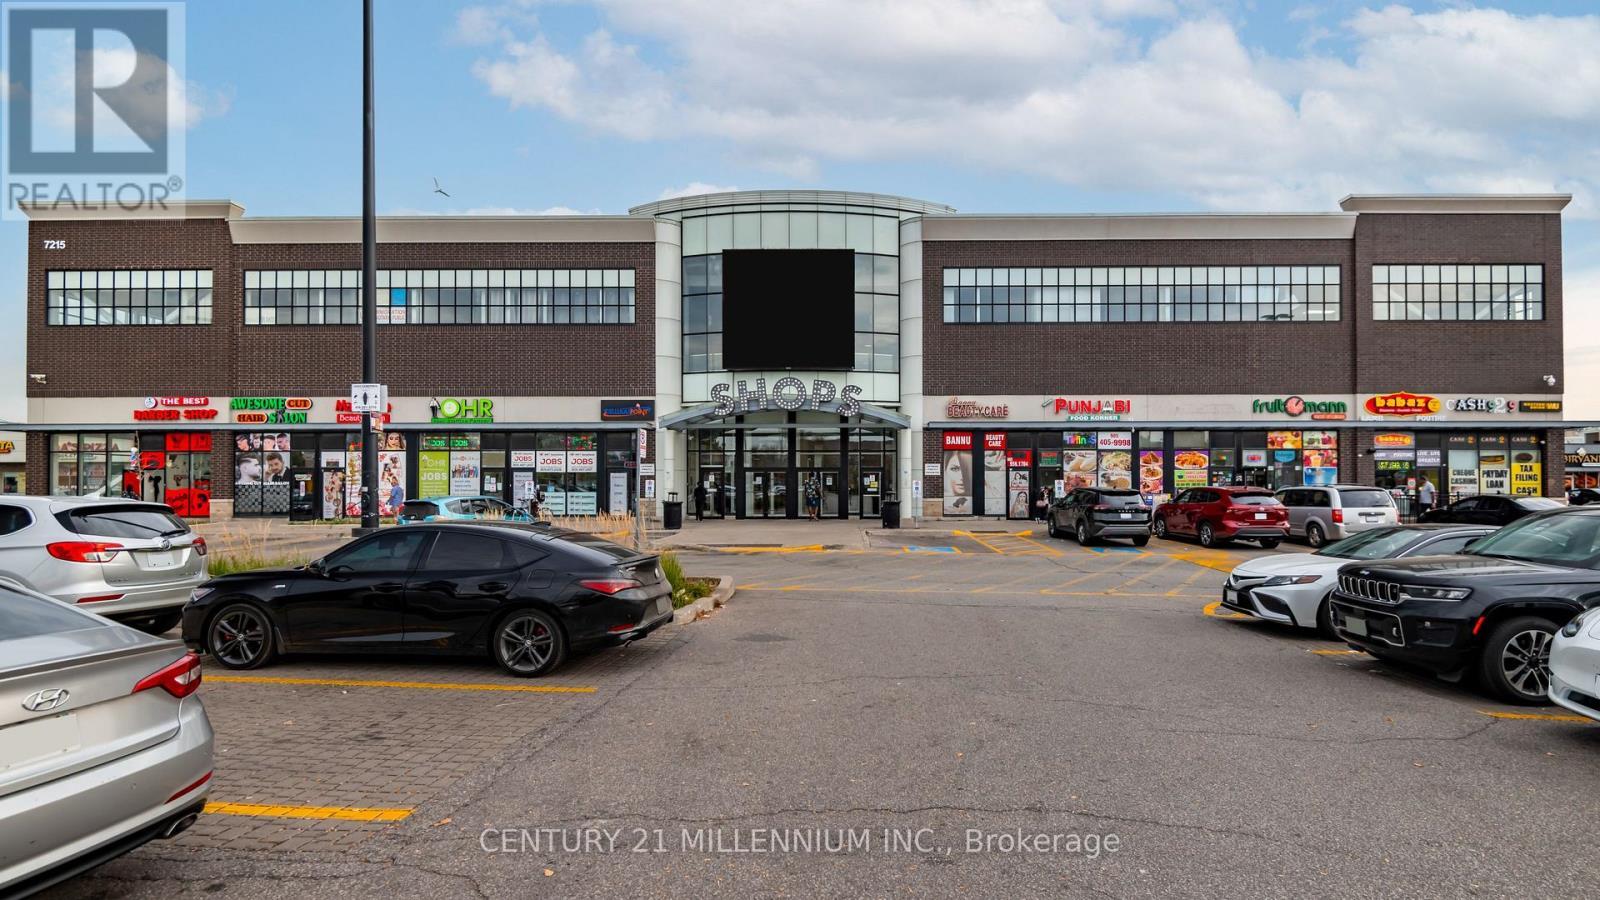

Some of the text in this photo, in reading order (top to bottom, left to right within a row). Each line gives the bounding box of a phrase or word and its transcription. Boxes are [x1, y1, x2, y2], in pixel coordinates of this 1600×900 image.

[44, 240, 66, 249] 7215
[711, 377, 863, 417] SHOPS
[1376, 395, 1426, 407] babaz
[231, 398, 308, 410] AWESOME CUT
[1054, 398, 1131, 414] PUNJABI
[1446, 399, 1486, 411] CASH
[184, 409, 218, 420] SHOP
[947, 405, 1009, 416] BEAUTY CARE
[945, 436, 971, 445] BANNU
[1520, 464, 1533, 472] TAX
[423, 472, 447, 480] JOBS
[1482, 469, 1508, 478] PAYDAY
[1516, 474, 1538, 482] FILING
[1486, 480, 1504, 488] LOAN
